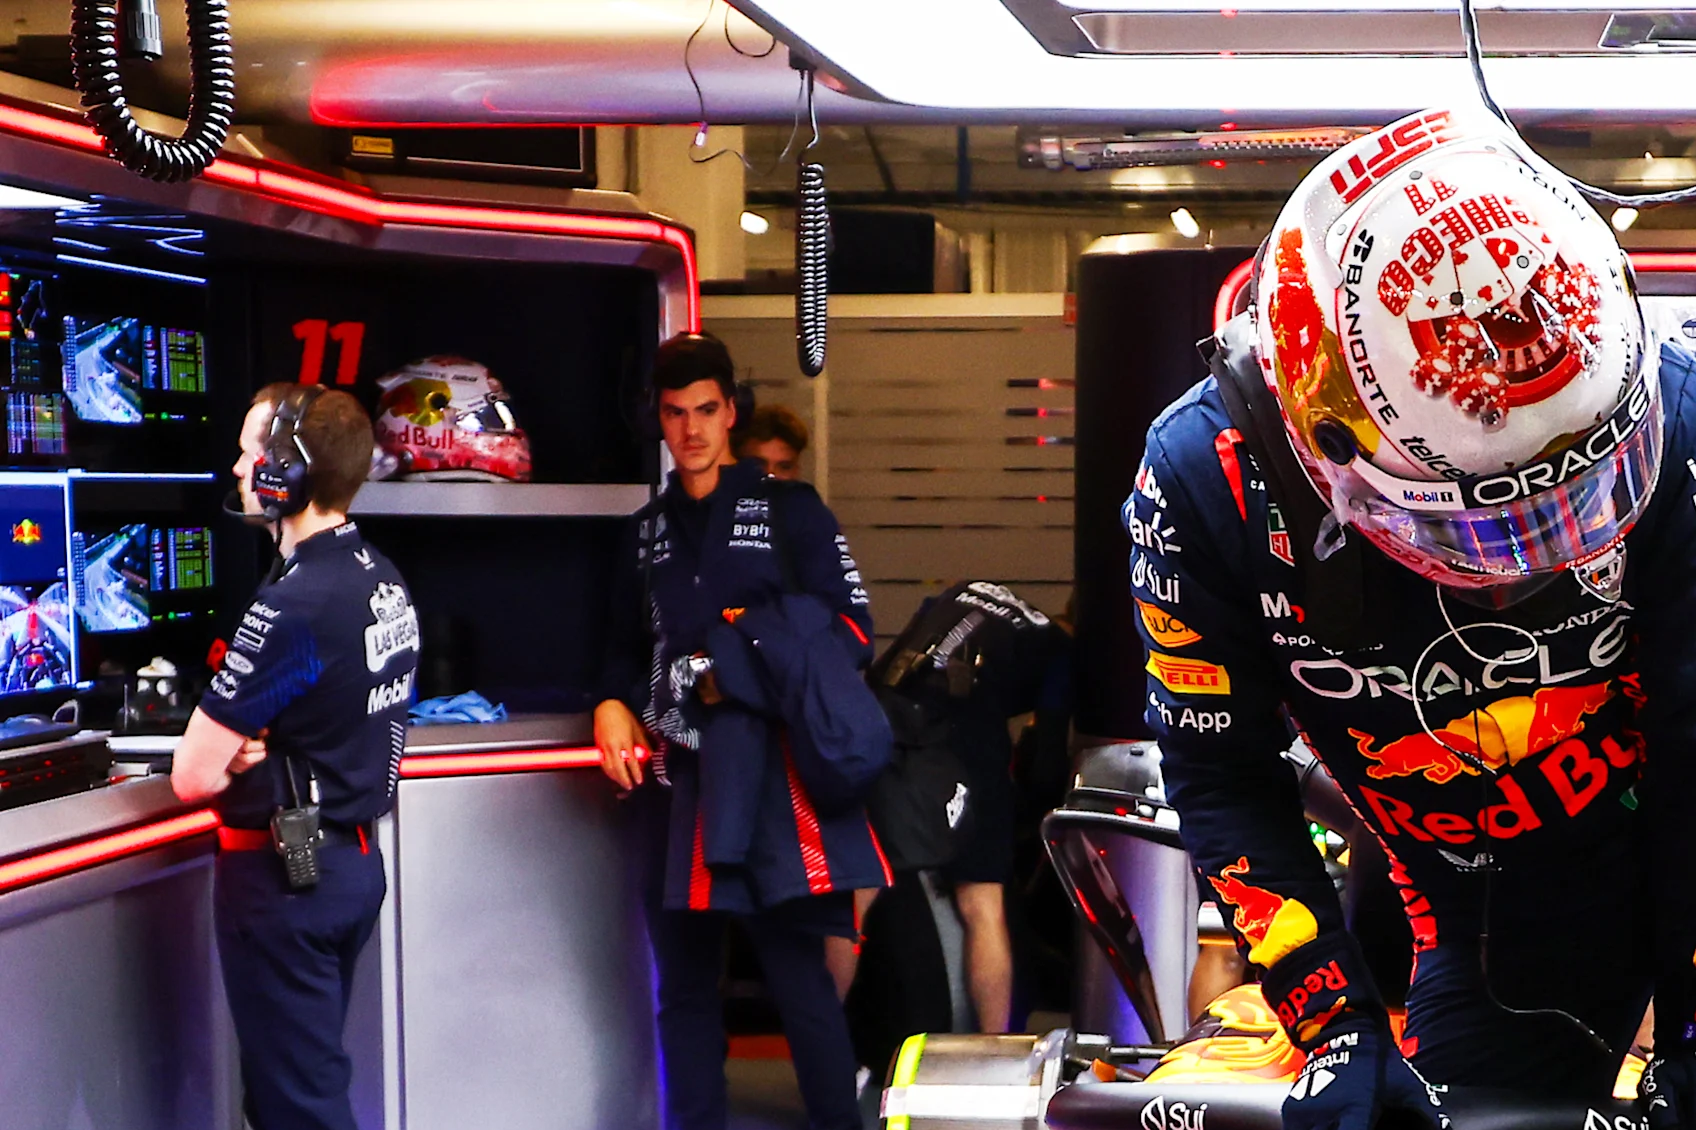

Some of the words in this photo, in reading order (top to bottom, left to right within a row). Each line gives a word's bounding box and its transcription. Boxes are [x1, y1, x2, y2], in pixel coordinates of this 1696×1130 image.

[292, 319, 366, 385] 11
[1344, 264, 1399, 426] BANORTE
[414, 427, 454, 450] Bull
[1472, 381, 1651, 505] ORACLE
[1403, 489, 1440, 503] Mobil
[733, 523, 770, 538] BYBIT
[729, 539, 772, 550] HONDA
[955, 591, 1011, 617] Mobil
[374, 632, 392, 656] LAS
[1290, 615, 1631, 701] ORACLE
[1166, 671, 1219, 687] ELLI
[367, 674, 411, 715] Mobil
[1179, 707, 1232, 733] App
[1358, 774, 1543, 845] Red
[1538, 734, 1638, 818] Bu
[1287, 959, 1349, 1018] Red
